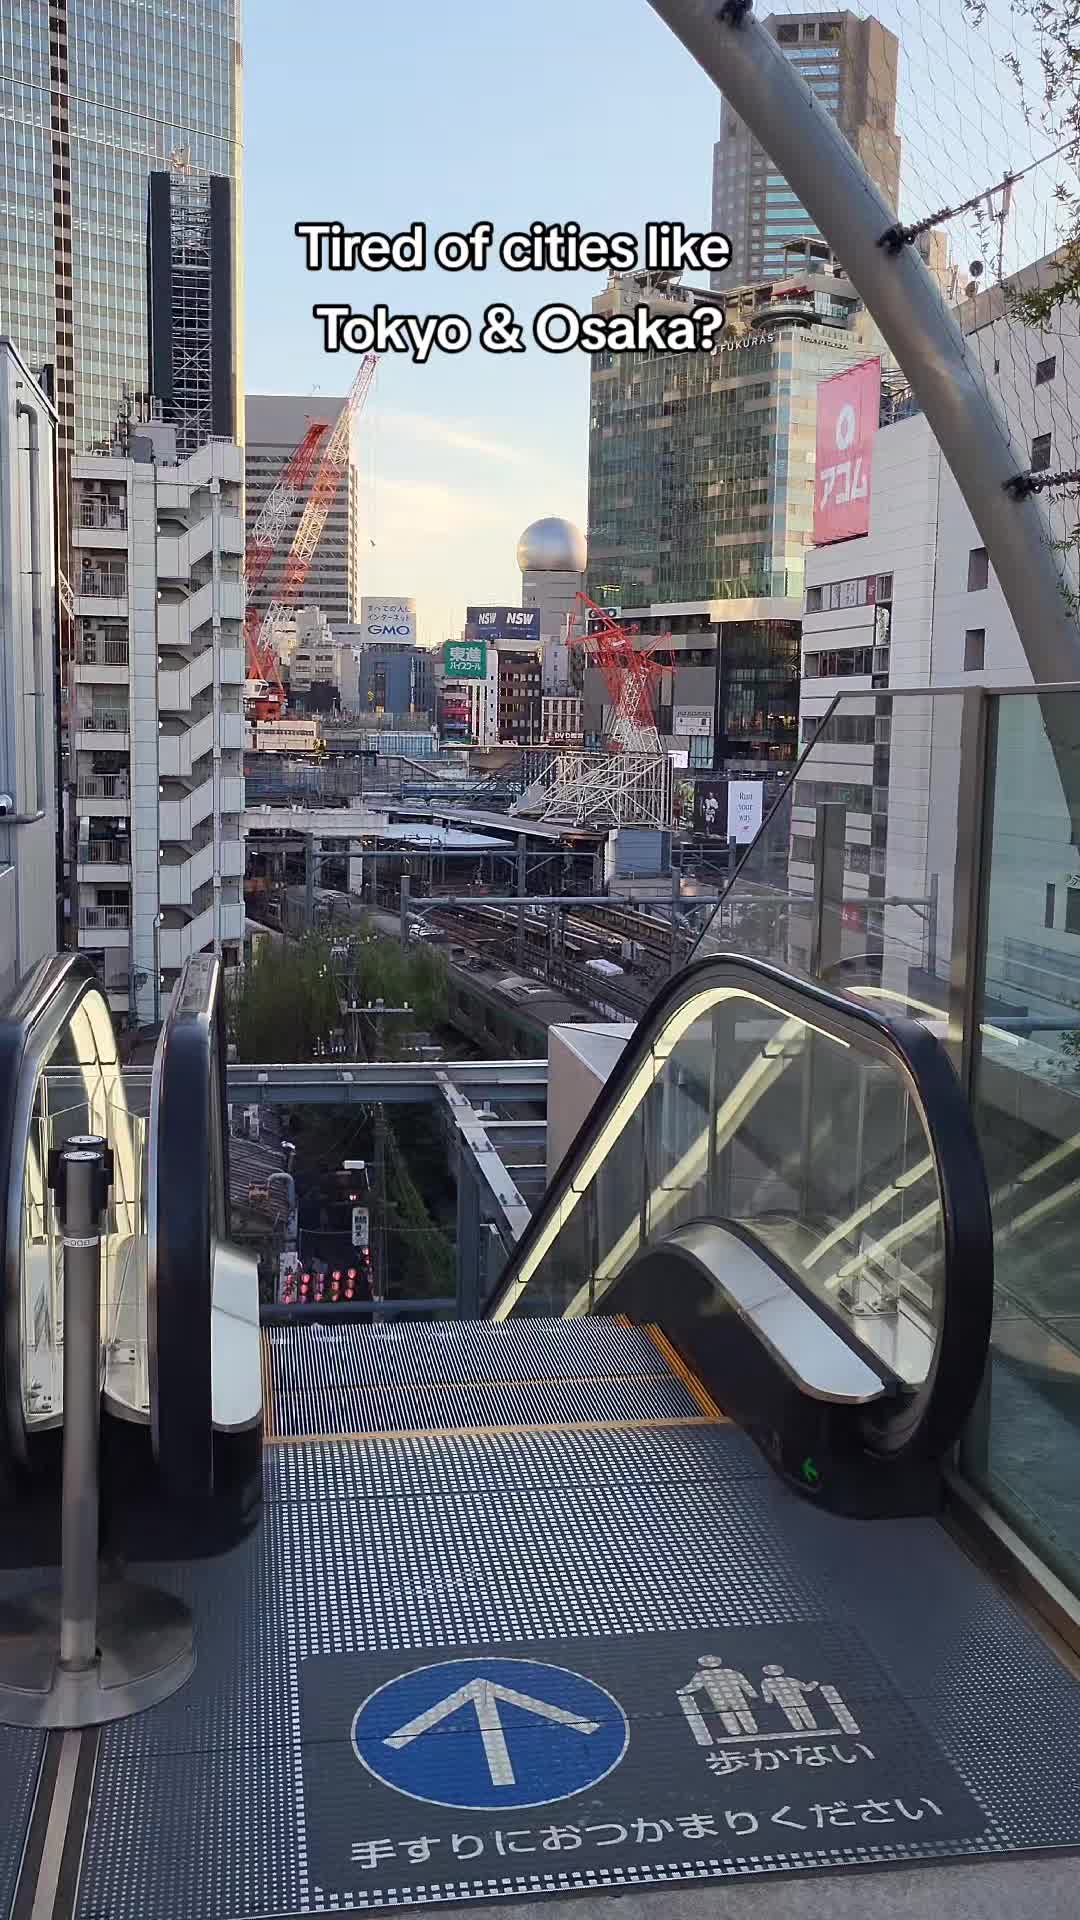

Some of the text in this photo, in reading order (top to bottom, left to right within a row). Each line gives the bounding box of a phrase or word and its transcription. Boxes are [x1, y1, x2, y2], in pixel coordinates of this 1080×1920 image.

[720, 333, 774, 353] FUKURAS
[820, 456, 869, 512] アコム
[479, 612, 497, 624] NSW
[506, 612, 534, 624] NSW
[368, 625, 410, 635] GMO
[450, 646, 481, 662] 東進
[450, 662, 481, 671] ハイスクール
[706, 1744, 875, 1776] 歩かない
[351, 1797, 944, 1869] 手すりにおつかまりください
